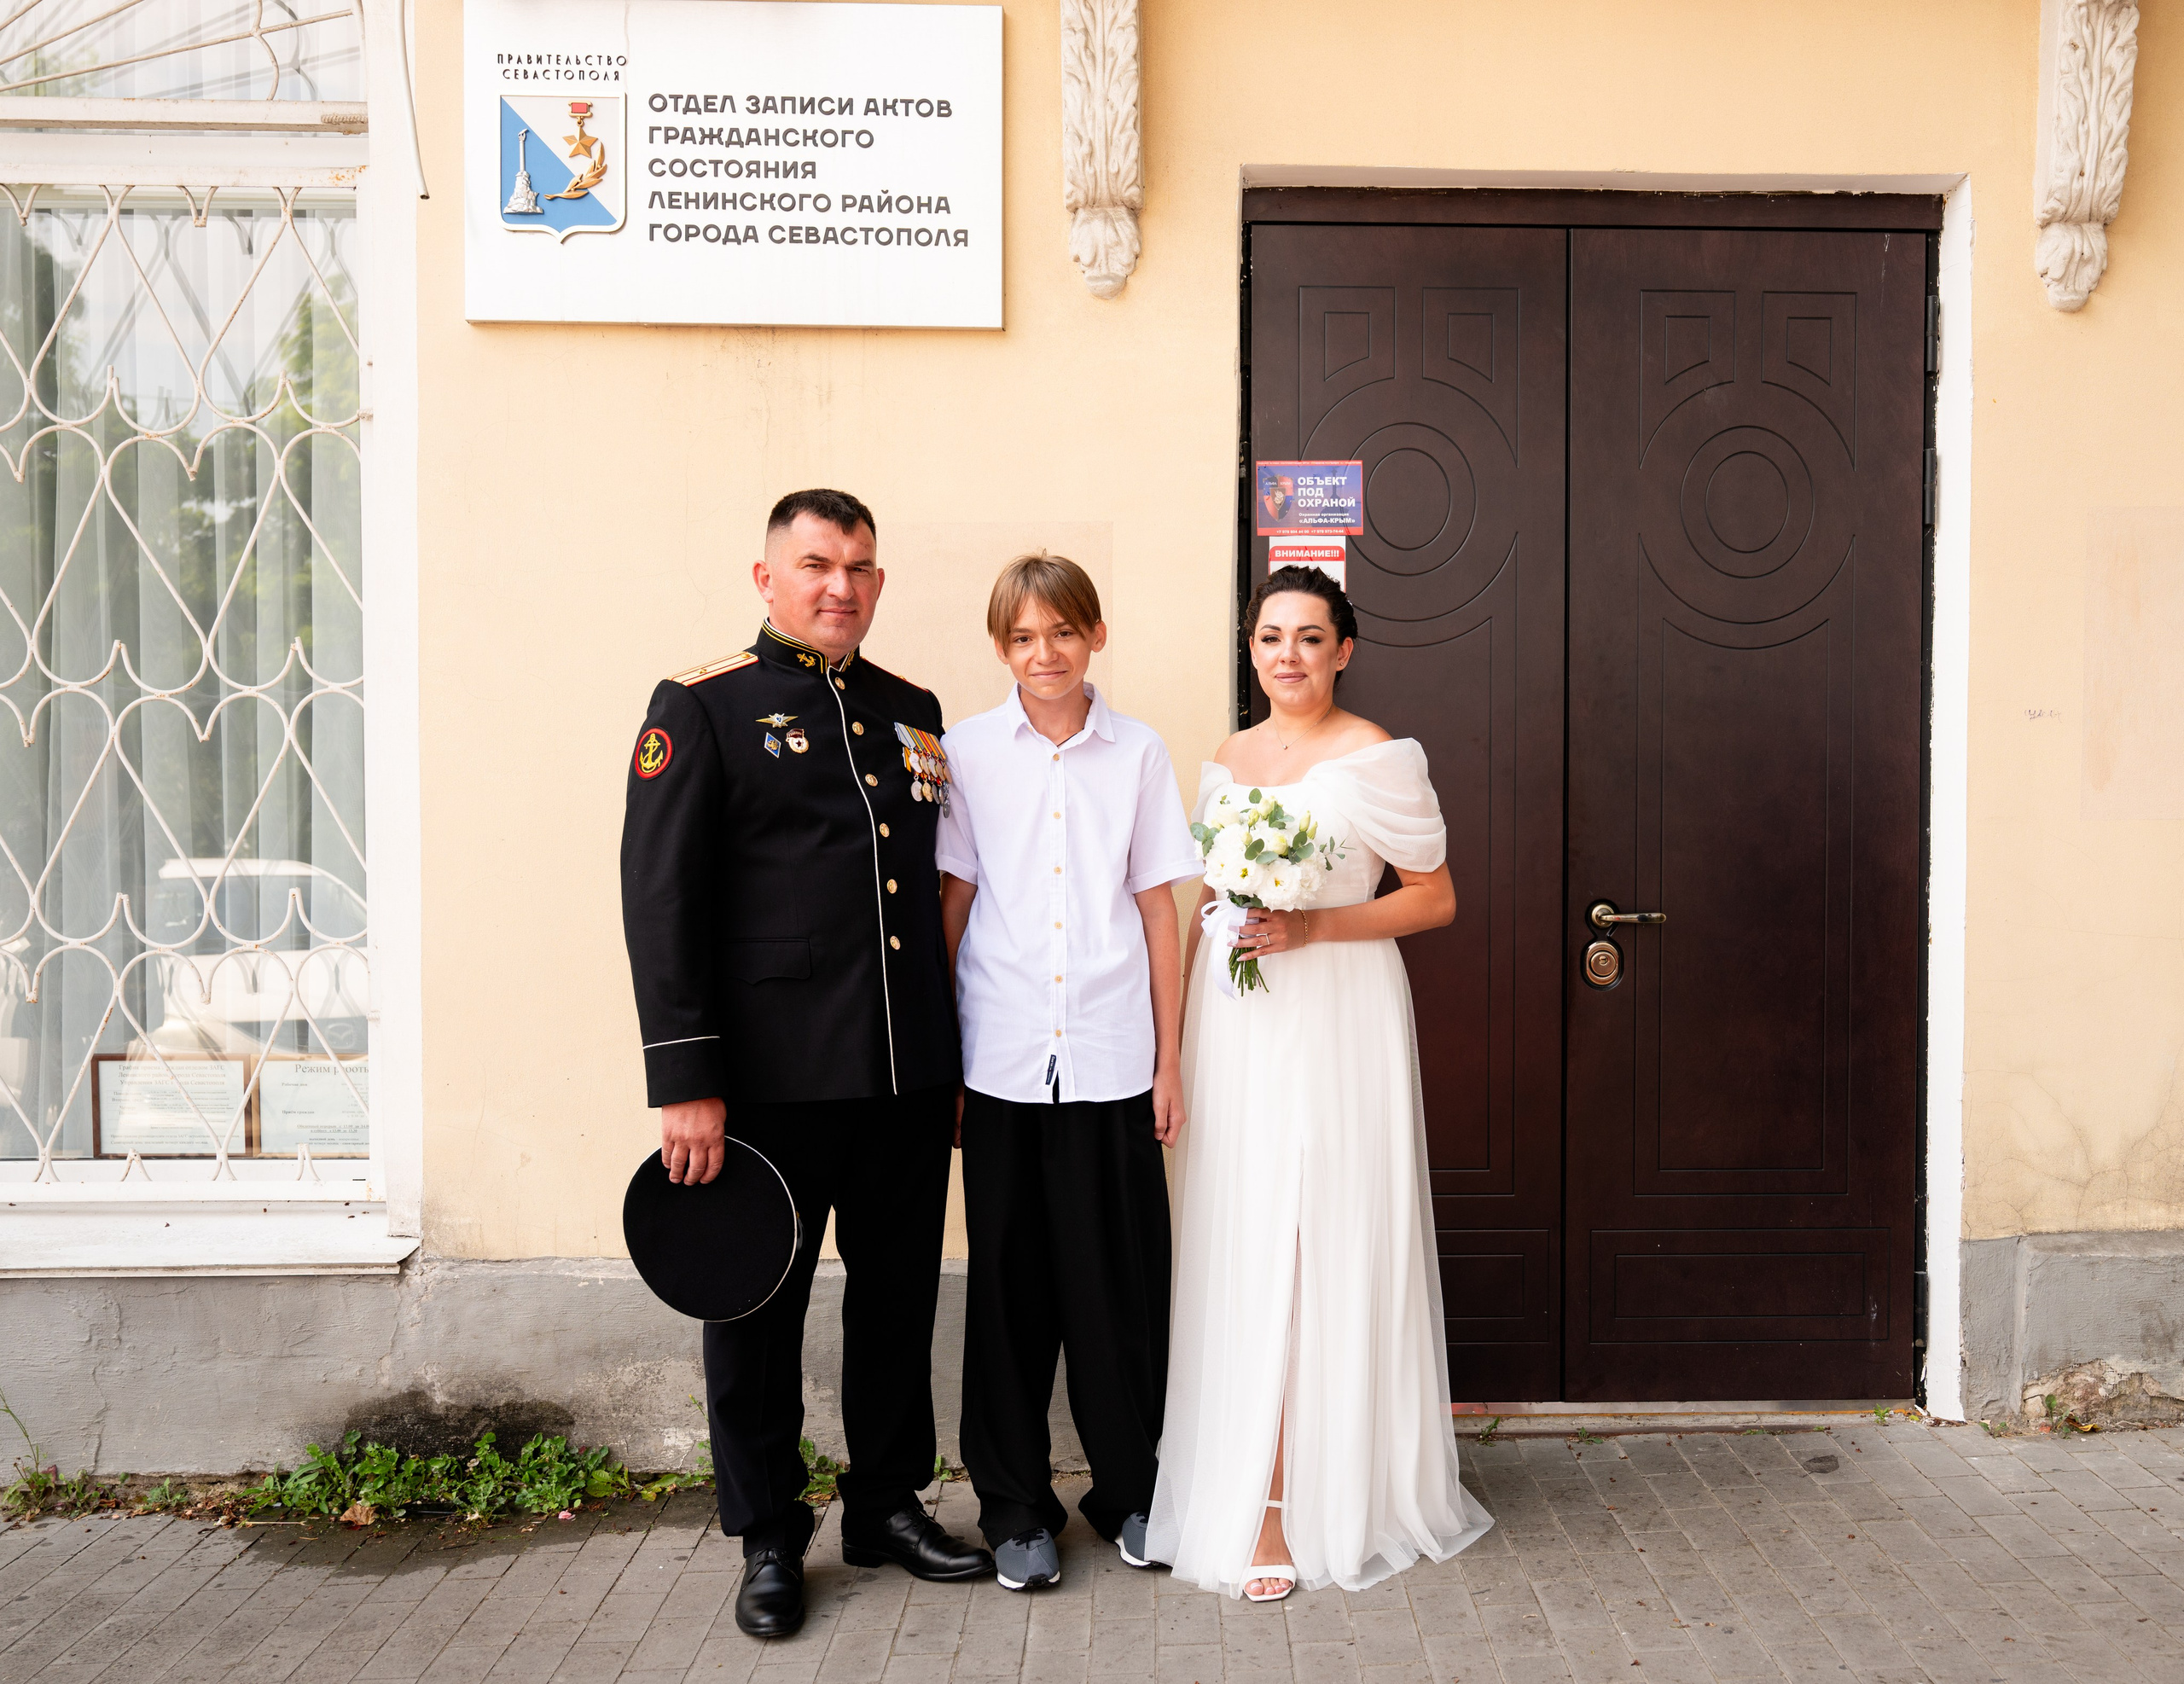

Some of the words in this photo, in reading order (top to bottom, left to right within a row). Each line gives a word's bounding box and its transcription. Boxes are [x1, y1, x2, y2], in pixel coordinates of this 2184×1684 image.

[498, 54, 628, 66] ПРАВИТЕЛЬСТВО
[502, 68, 620, 81] СЕВАСТОПОЛЯ
[648, 93, 737, 114] ОТДЕЛ
[746, 95, 854, 116] ЗАПИСИ
[864, 98, 953, 118] АКТОВ
[648, 125, 874, 148] ГРАЖДАНСКОГО
[648, 158, 816, 179] СОСТОЯНИЯ
[648, 190, 832, 212] ЛЕНИНСКОГО
[842, 189, 951, 214] РАЙОНА
[649, 223, 759, 246] ГОРОДА
[769, 224, 969, 247] СЕВАСТОПОЛЯ
[1298, 476, 1347, 485] ОБЪЕКТ
[1298, 488, 1324, 498] ПОД
[1298, 496, 1356, 508] ОХРАНОЙ
[1275, 549, 1339, 558] ВНИМАНИЕ!!!
[295, 1065, 330, 1073] Режим
